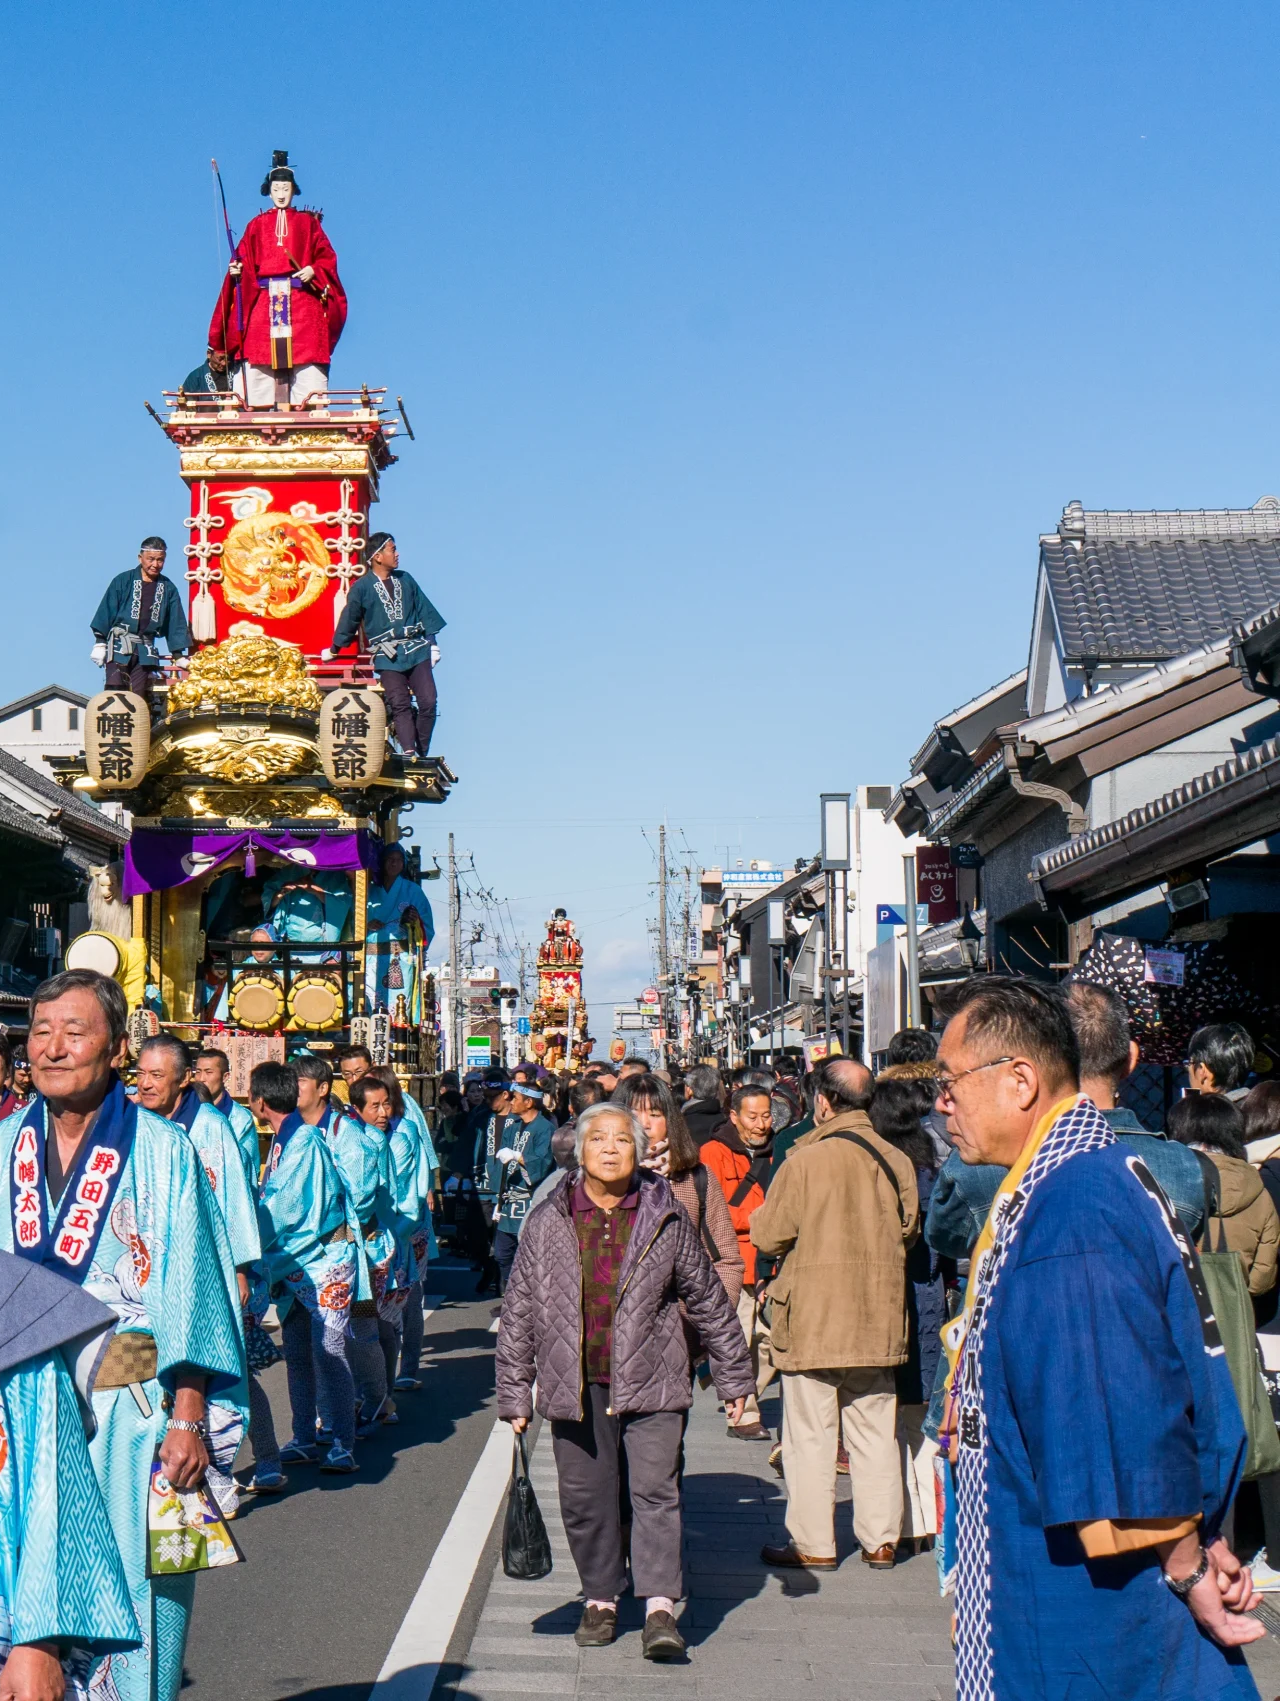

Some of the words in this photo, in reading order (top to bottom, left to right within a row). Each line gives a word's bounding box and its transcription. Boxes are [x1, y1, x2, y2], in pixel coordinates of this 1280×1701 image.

[97, 692, 136, 783] 八幡太郎
[331, 691, 371, 781] 八幡太郎
[880, 910, 890, 921] P
[17, 1130, 38, 1243] 八幡太郎
[59, 1150, 116, 1261] 野田五町
